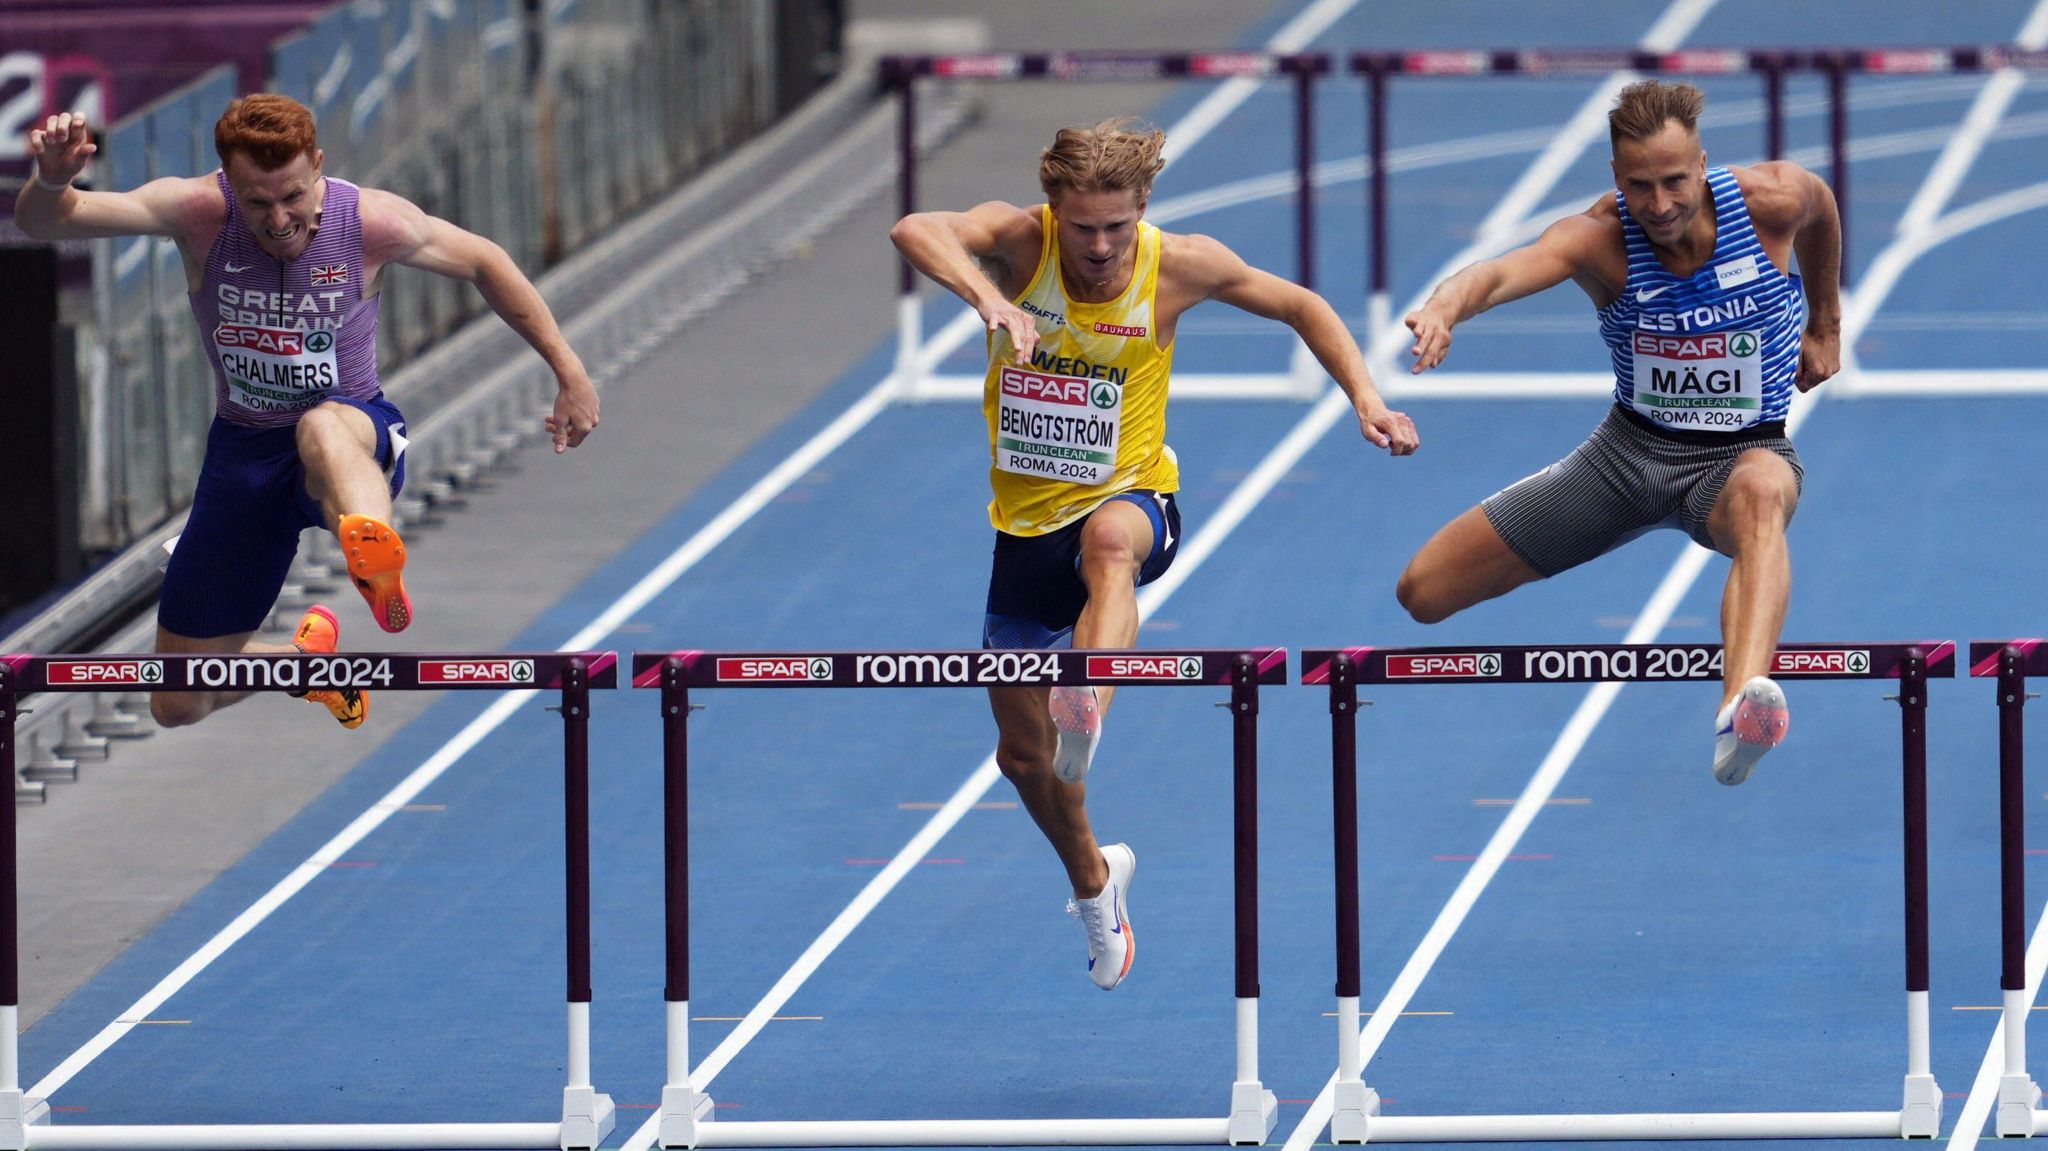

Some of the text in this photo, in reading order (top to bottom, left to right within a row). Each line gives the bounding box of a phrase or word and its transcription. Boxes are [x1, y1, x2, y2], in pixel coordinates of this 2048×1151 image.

[218, 283, 343, 313] GREAT
[1021, 301, 1058, 323] CRAFT
[1638, 295, 1759, 331] ESTONIA
[1094, 323, 1146, 336] BAUHAUS
[217, 328, 300, 353] SPAR
[1636, 336, 1724, 357] SPAR
[221, 353, 333, 390] CHALMERS
[1031, 346, 1128, 386] WEDEN
[1004, 373, 1086, 402] SPAR
[1651, 367, 1741, 394] MÄGI
[251, 385, 273, 398] RUN
[242, 394, 286, 411] ROMA
[1664, 398, 1691, 407] RUN
[1001, 406, 1114, 448] BENGTSTRÖM
[1651, 410, 1744, 426] ROMA 2024
[1022, 444, 1048, 456] RUN
[1010, 456, 1098, 480] ROMA 2024
[442, 664, 509, 680] SPAR
[741, 661, 807, 677] SPAR
[856, 653, 1063, 682] roma 2024
[1111, 660, 1177, 676] SPAR
[1410, 657, 1475, 674] SPAR
[1525, 649, 1725, 679] roma 2024
[1778, 653, 1843, 670] SPAR
[71, 665, 137, 681] SPAR
[187, 658, 394, 687] roma 2024
